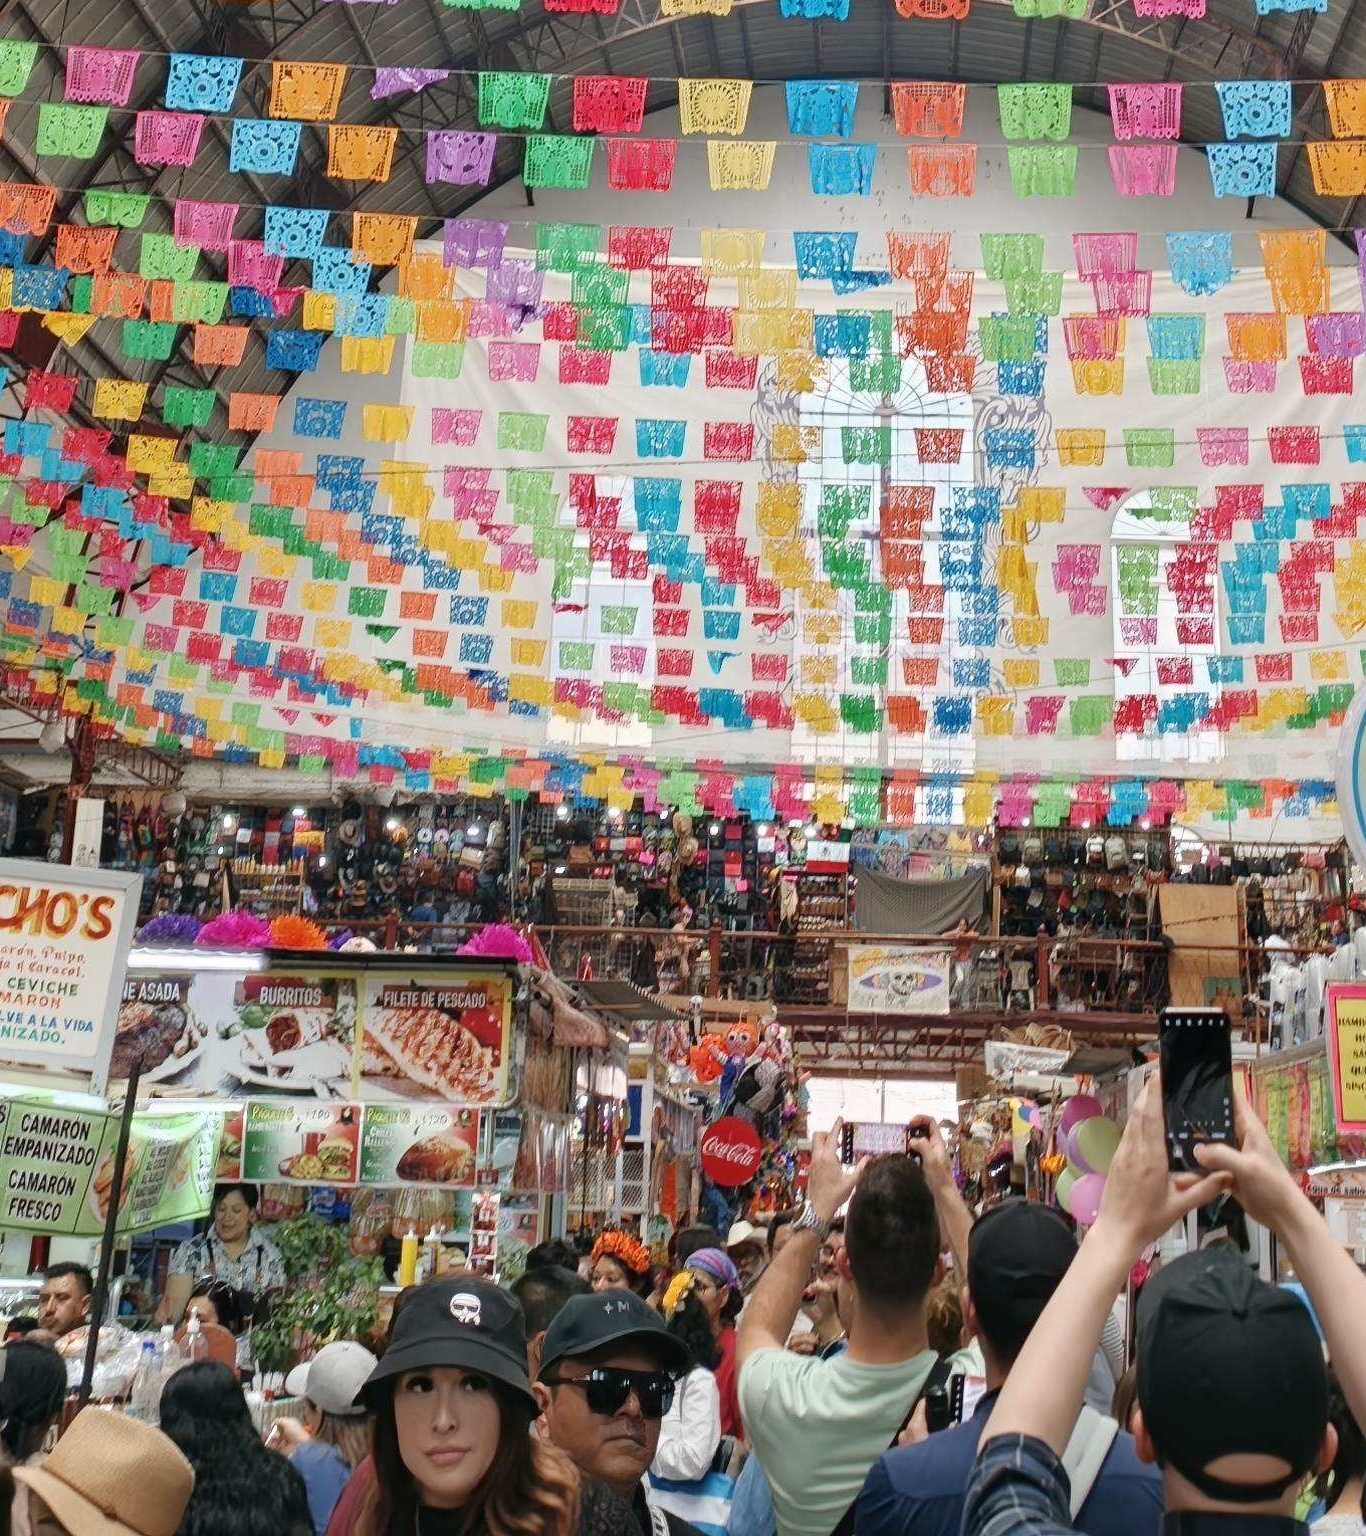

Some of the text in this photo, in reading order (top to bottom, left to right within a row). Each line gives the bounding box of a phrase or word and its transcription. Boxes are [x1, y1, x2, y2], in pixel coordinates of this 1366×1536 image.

[7, 976, 79, 996] CEVICHE
[138, 981, 180, 1001] ASADA
[259, 986, 322, 1006] BURRITOS
[383, 991, 486, 1008] FILETE DE PESCADO
[40, 1015, 57, 1029] LA
[63, 1019, 94, 1032] VIDA
[20, 1114, 91, 1142] CAMARÓN
[4, 1136, 96, 1166] EMPANIZADO
[702, 1136, 758, 1166] Coca-Cola
[8, 1168, 77, 1196] CAMARÓN
[7, 1197, 62, 1222] FRESCO
